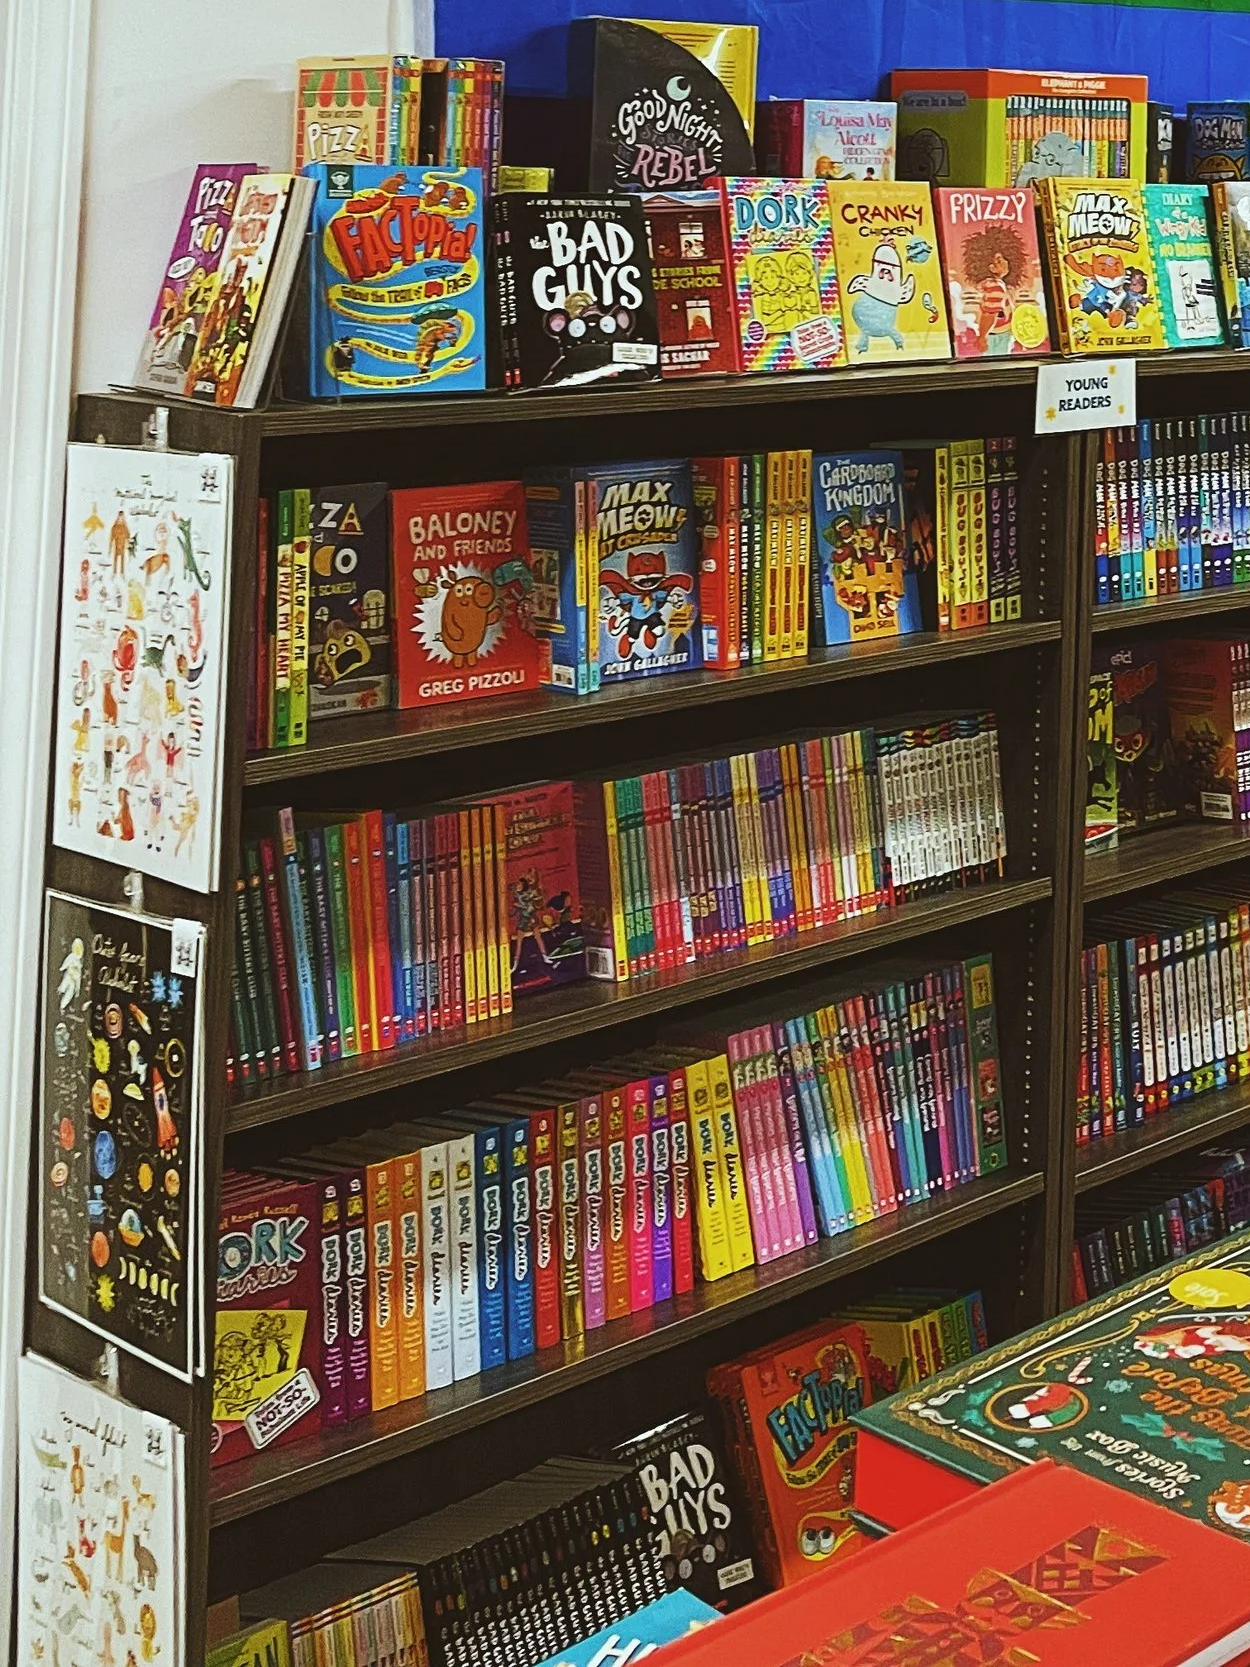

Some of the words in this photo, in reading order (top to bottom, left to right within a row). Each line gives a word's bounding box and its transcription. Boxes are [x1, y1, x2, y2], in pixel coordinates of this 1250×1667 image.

[656, 101, 723, 147] NIGHT
[836, 131, 877, 146] Alcott
[631, 143, 716, 188] REBEL
[734, 194, 819, 231] DORK
[842, 203, 923, 227] CRANKY
[950, 190, 1027, 225] FRIZZY
[1074, 193, 1127, 214] MAX
[1162, 193, 1193, 206] DIARY
[546, 220, 634, 267] BAD
[859, 226, 914, 237] CHICKEN
[1069, 212, 1133, 240] MEOW
[532, 261, 643, 311] GUYS
[671, 276, 723, 290] SCHOOL
[1066, 377, 1108, 392] YOUNG
[1059, 396, 1111, 412] READERS
[819, 461, 895, 489] CARDBOARD
[602, 481, 672, 510] MAX
[824, 483, 895, 512] KINGDOM
[409, 510, 516, 545] BALONEY
[597, 503, 679, 541] MEOW
[413, 545, 446, 562] AND
[454, 538, 512, 556] FRIENDS
[419, 681, 464, 698] GREG
[469, 670, 525, 690] PIZZOLI
[512, 1176, 530, 1222] DORK
[535, 1166, 552, 1210] DORK
[562, 1159, 578, 1203] DORK
[429, 1205, 443, 1246] DORK
[459, 1195, 471, 1236] DORK
[483, 1185, 499, 1232] DORK
[217, 1216, 309, 1284] ORK
[347, 1228, 365, 1276] DORK
[374, 1220, 391, 1268] DORK
[401, 1211, 417, 1258] DORK
[322, 1234, 340, 1283] DORK
[1184, 1283, 1228, 1306] Sale
[1121, 1361, 1238, 1406] Before
[1085, 1430, 1139, 1455] Box
[639, 1444, 716, 1513] BAD
[1114, 1461, 1185, 1500] Stories
[1134, 1445, 1201, 1484] Music
